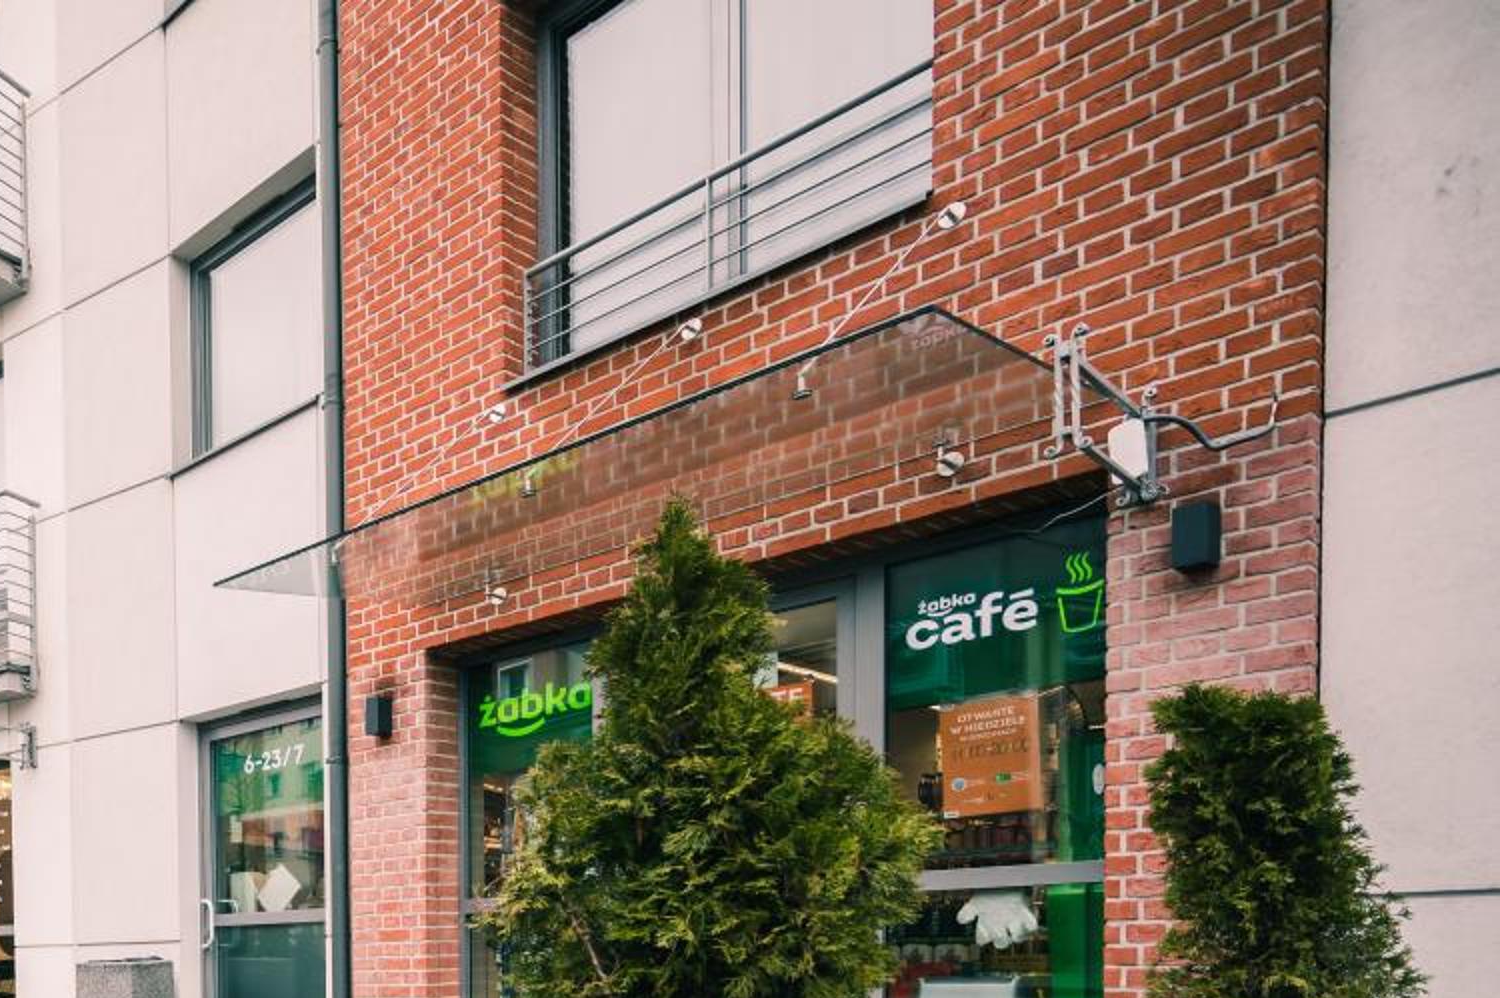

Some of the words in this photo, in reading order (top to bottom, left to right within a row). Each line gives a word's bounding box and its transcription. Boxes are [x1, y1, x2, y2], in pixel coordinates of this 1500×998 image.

[905, 586, 1039, 650] café
[918, 592, 976, 616] żabka
[479, 681, 592, 733] żabka
[244, 744, 305, 774] 6-23/7
